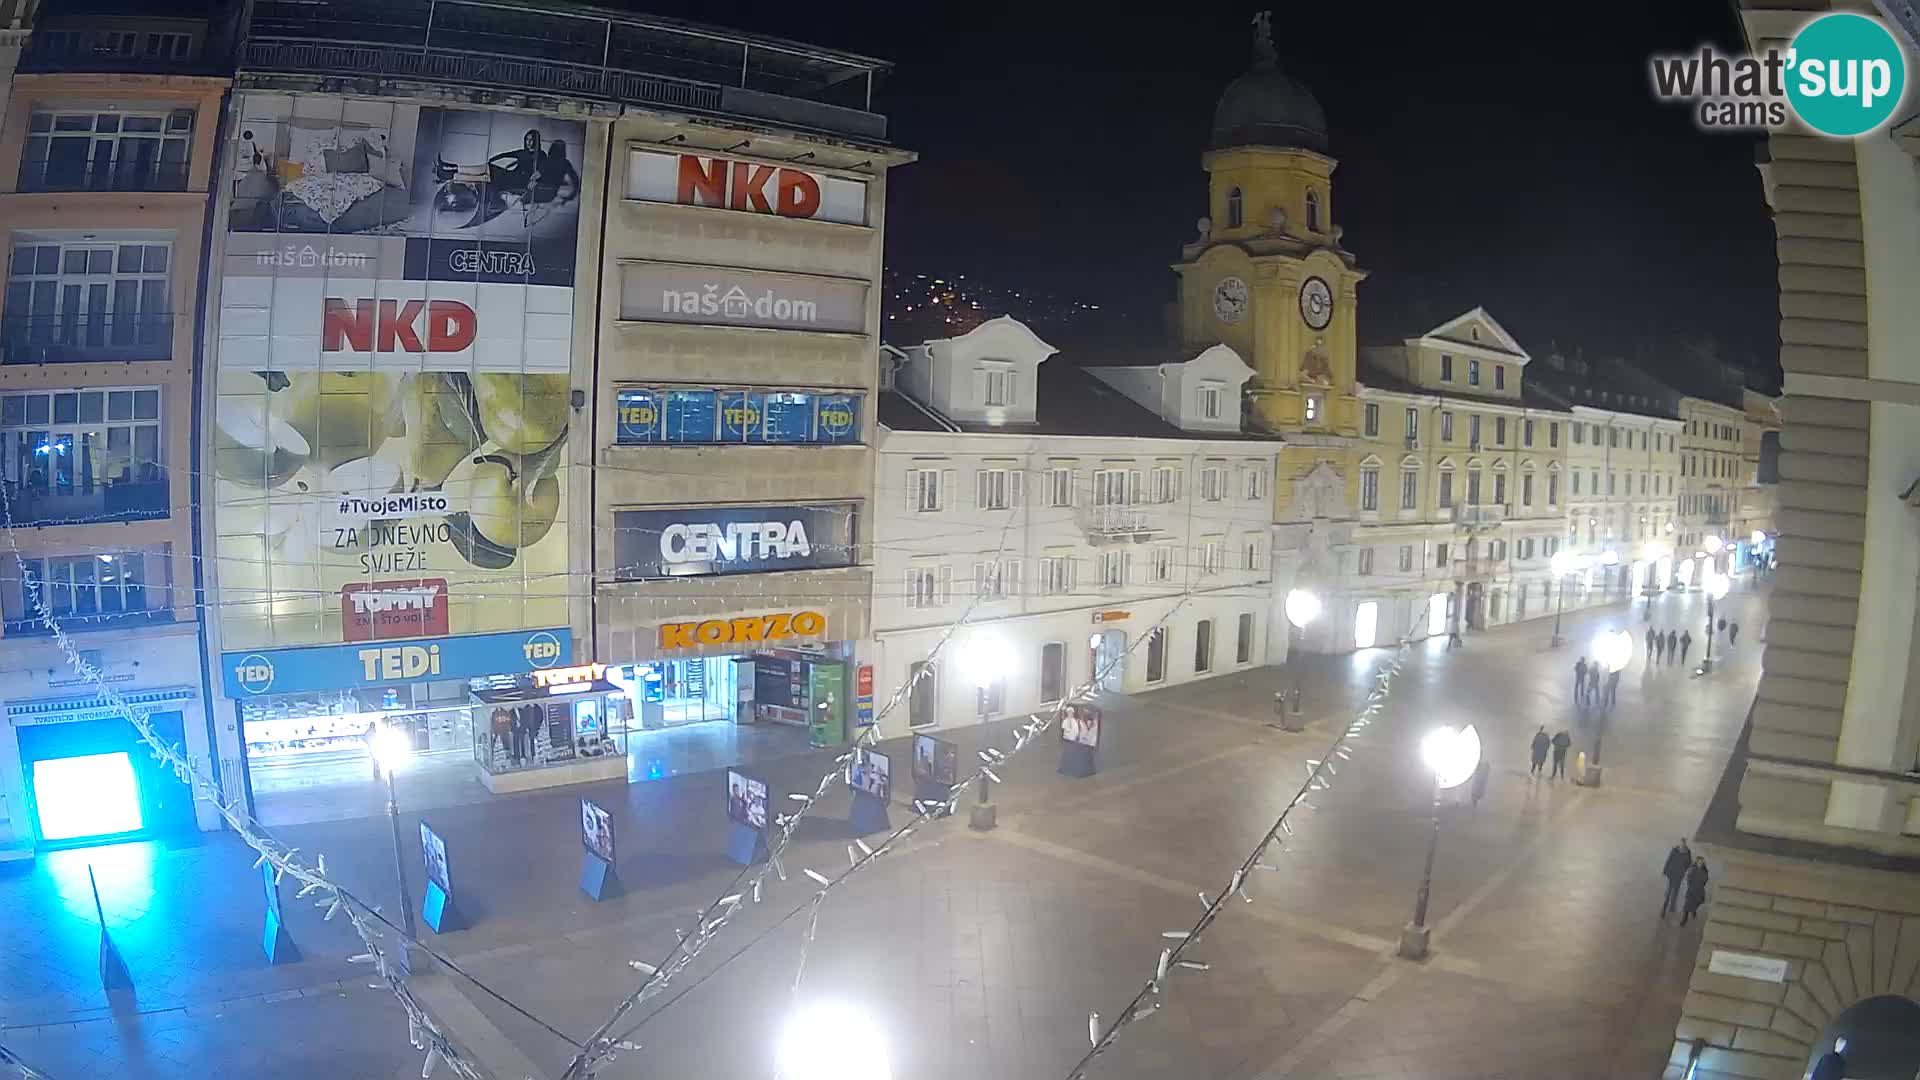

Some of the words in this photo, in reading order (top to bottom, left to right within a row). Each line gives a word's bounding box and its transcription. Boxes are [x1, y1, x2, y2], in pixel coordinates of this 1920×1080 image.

[677, 154, 821, 218] NKD
[320, 247, 367, 268] dom
[449, 249, 536, 275] CENTRA
[663, 284, 719, 315] naš
[755, 289, 817, 322] dom
[322, 297, 478, 353] NKD
[339, 496, 447, 515] #TvojeMisto
[335, 527, 359, 548] ZA
[367, 523, 451, 547] DNEVNO
[660, 520, 810, 563] CENTRA
[360, 546, 427, 574] SVJEŽE
[660, 611, 827, 650] KORZO
[359, 644, 441, 681] TEDi
[523, 641, 560, 660] TEDi
[235, 663, 274, 683] TEDi
